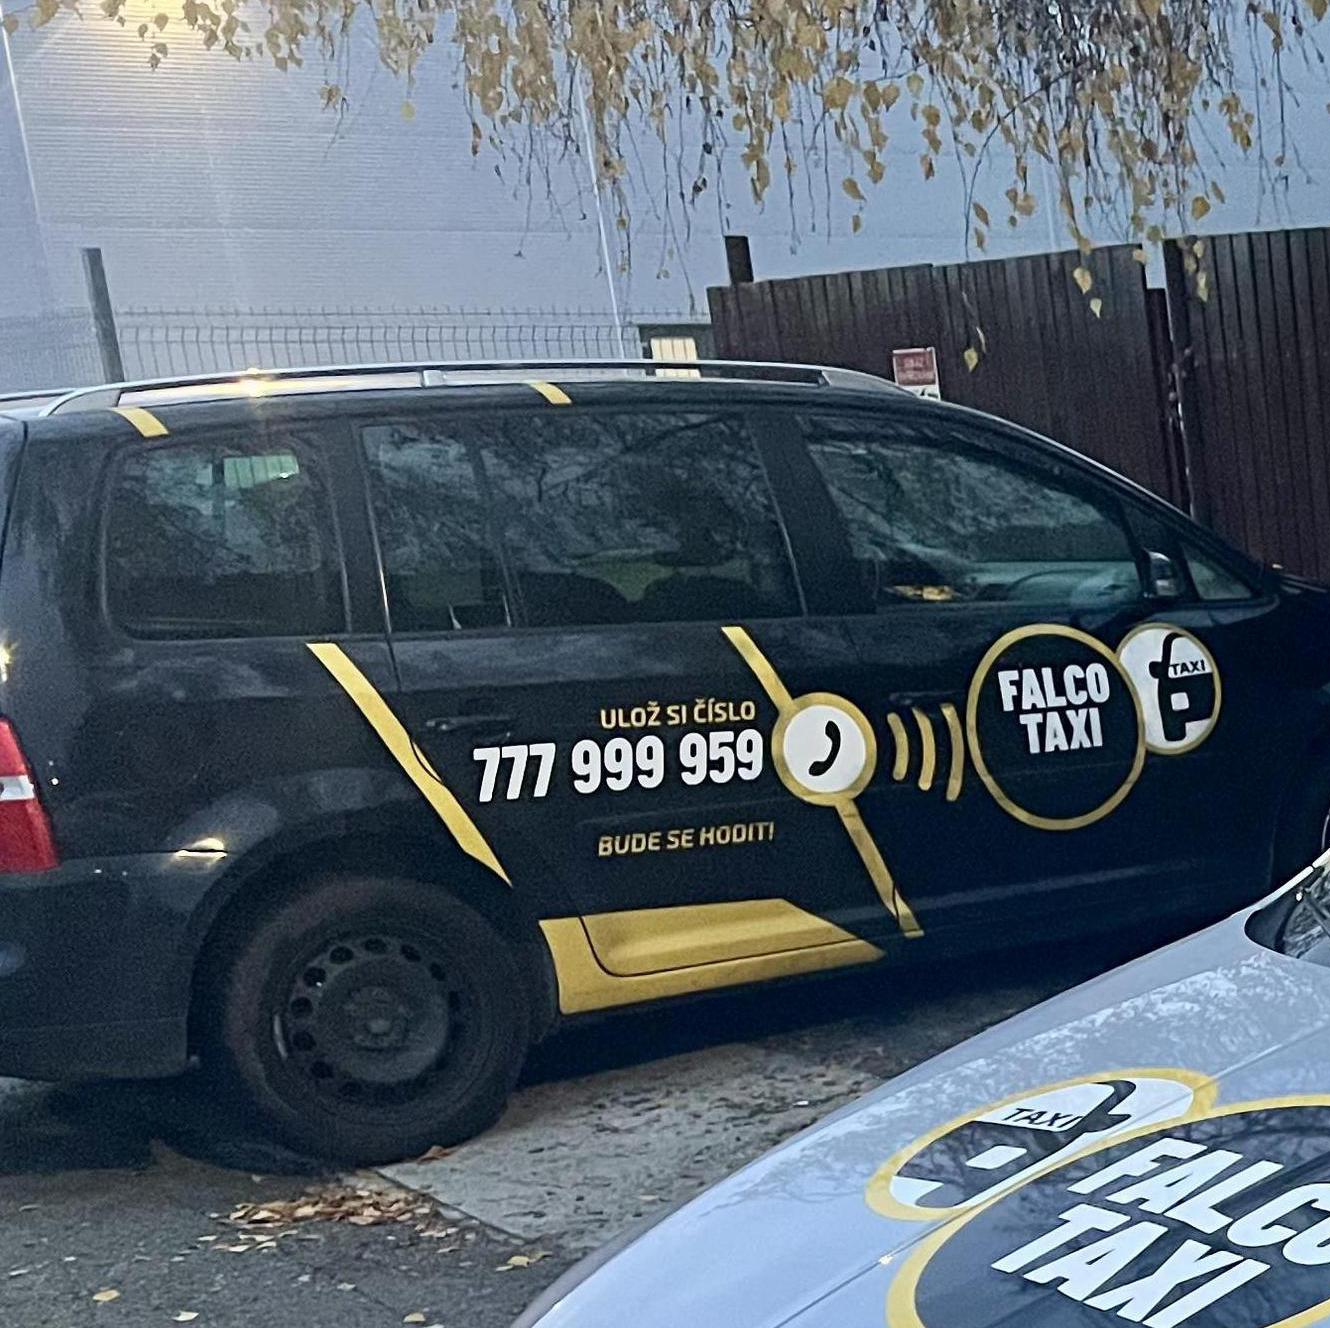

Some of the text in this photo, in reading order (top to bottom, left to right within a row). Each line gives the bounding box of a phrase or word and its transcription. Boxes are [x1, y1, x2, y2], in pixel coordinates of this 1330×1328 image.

[1170, 658, 1206, 676] TAXI
[997, 662, 1111, 712] FALCO
[601, 698, 756, 729] ULOŽ SI ČÍSLO
[1018, 708, 1103, 755] TAXI
[472, 728, 764, 802] 777 999 959
[598, 821, 775, 857] BUDE SE HODIT!
[1001, 1107, 1084, 1128] TAXI
